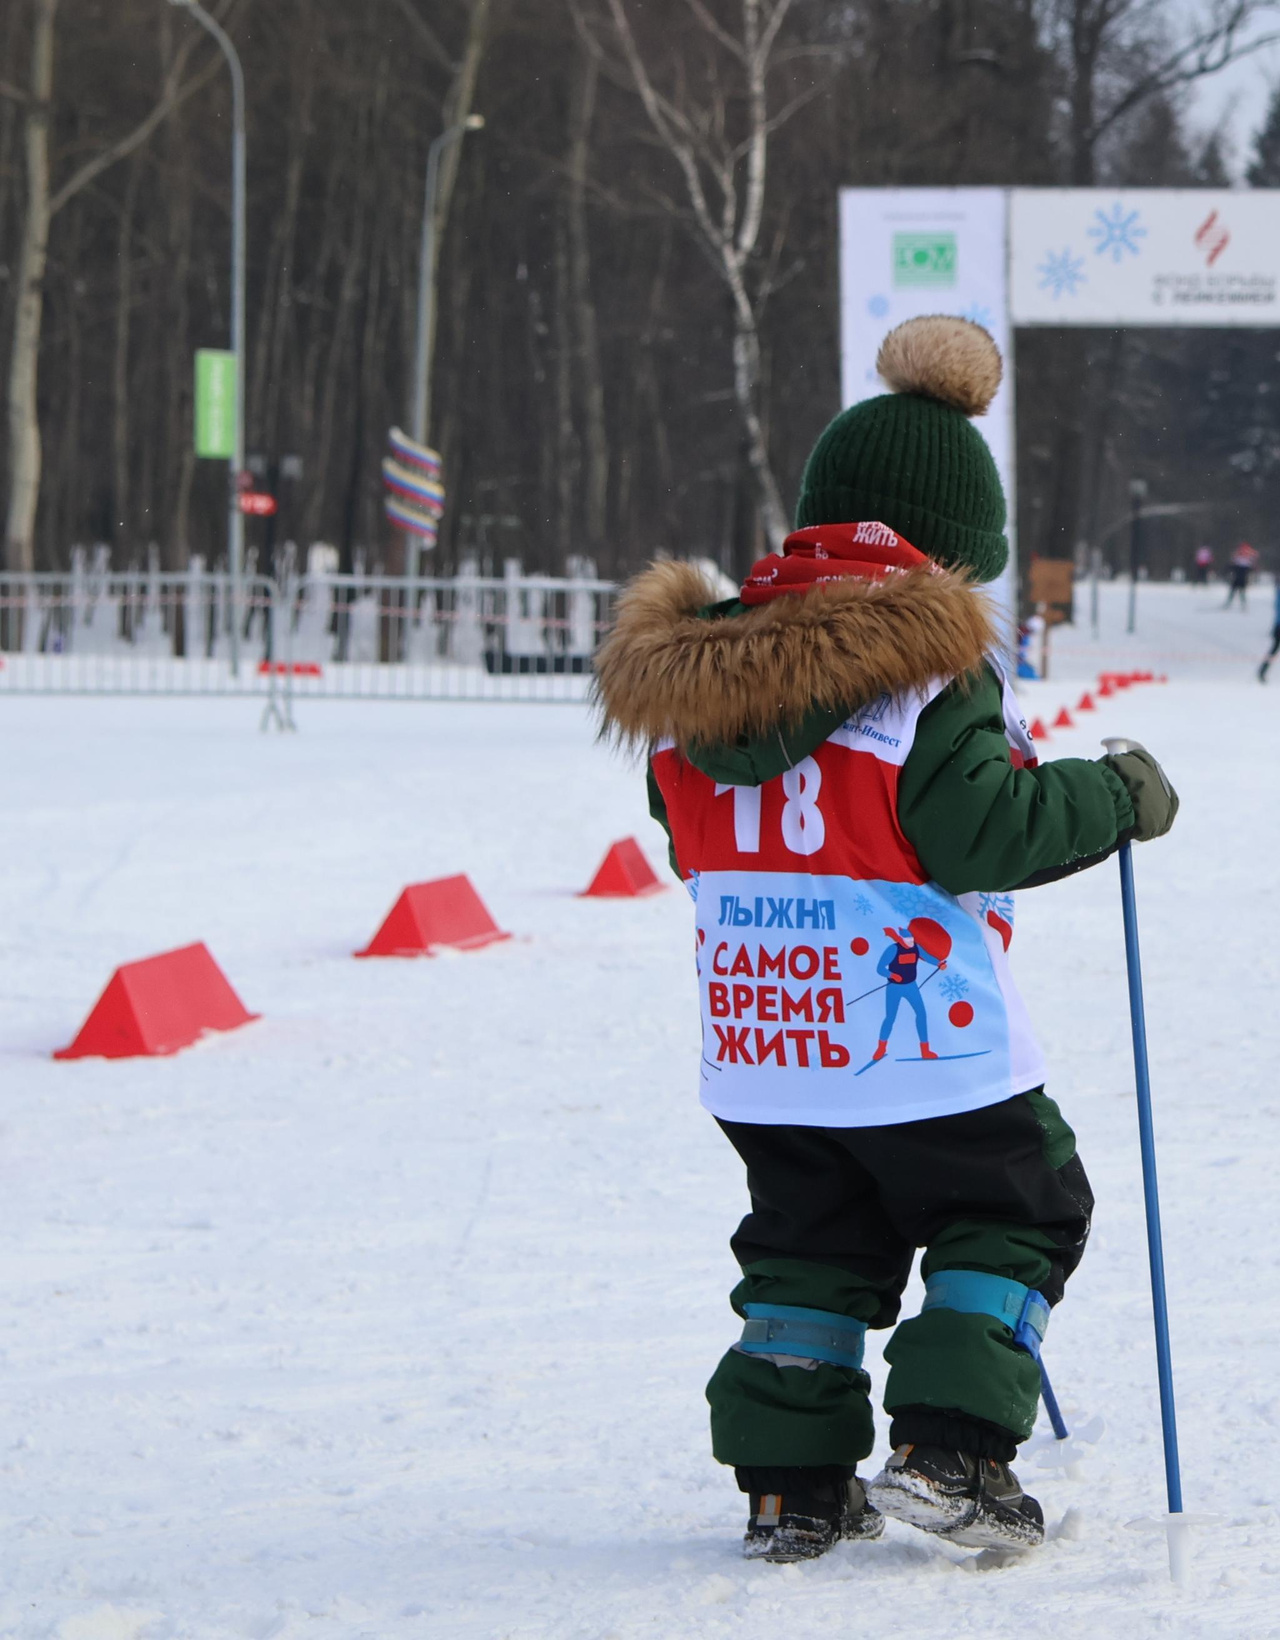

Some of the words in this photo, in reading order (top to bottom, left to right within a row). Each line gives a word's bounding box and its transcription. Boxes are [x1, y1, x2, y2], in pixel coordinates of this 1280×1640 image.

[853, 526, 898, 547] ЖИТЬ
[714, 754, 825, 856] 18
[718, 895, 836, 930] ЛЫЖНЯ
[713, 941, 842, 981] САМОЕ
[708, 981, 846, 1024] ВРЕМЯ
[711, 1023, 850, 1068] ЖИТЬ
